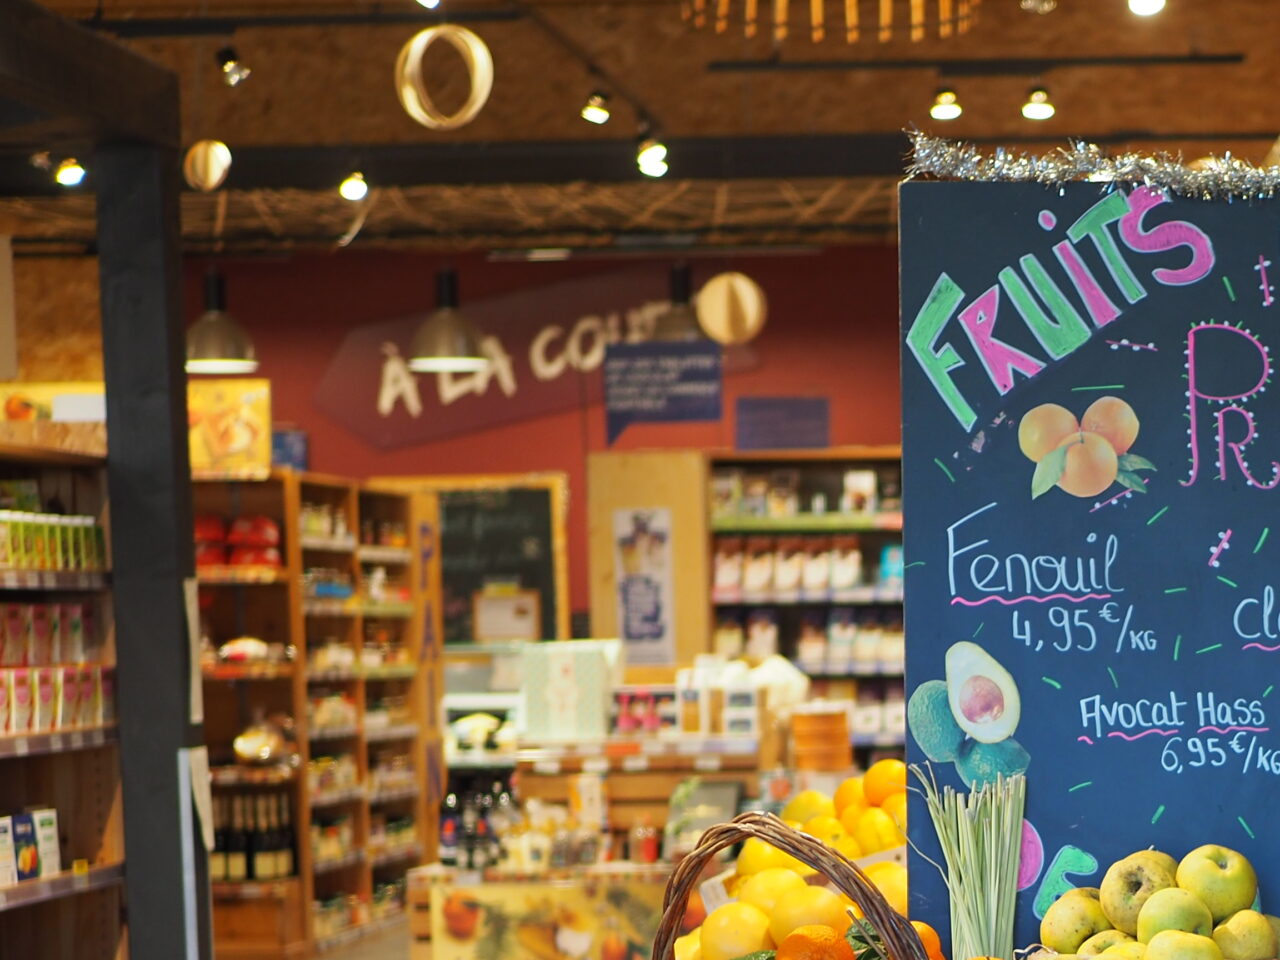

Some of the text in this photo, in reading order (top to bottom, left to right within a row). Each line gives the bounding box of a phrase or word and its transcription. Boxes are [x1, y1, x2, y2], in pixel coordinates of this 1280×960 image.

[906, 185, 1215, 432] FRUITS
[947, 501, 1125, 595] Fenouil
[1079, 691, 1266, 738] Avocat Hass
